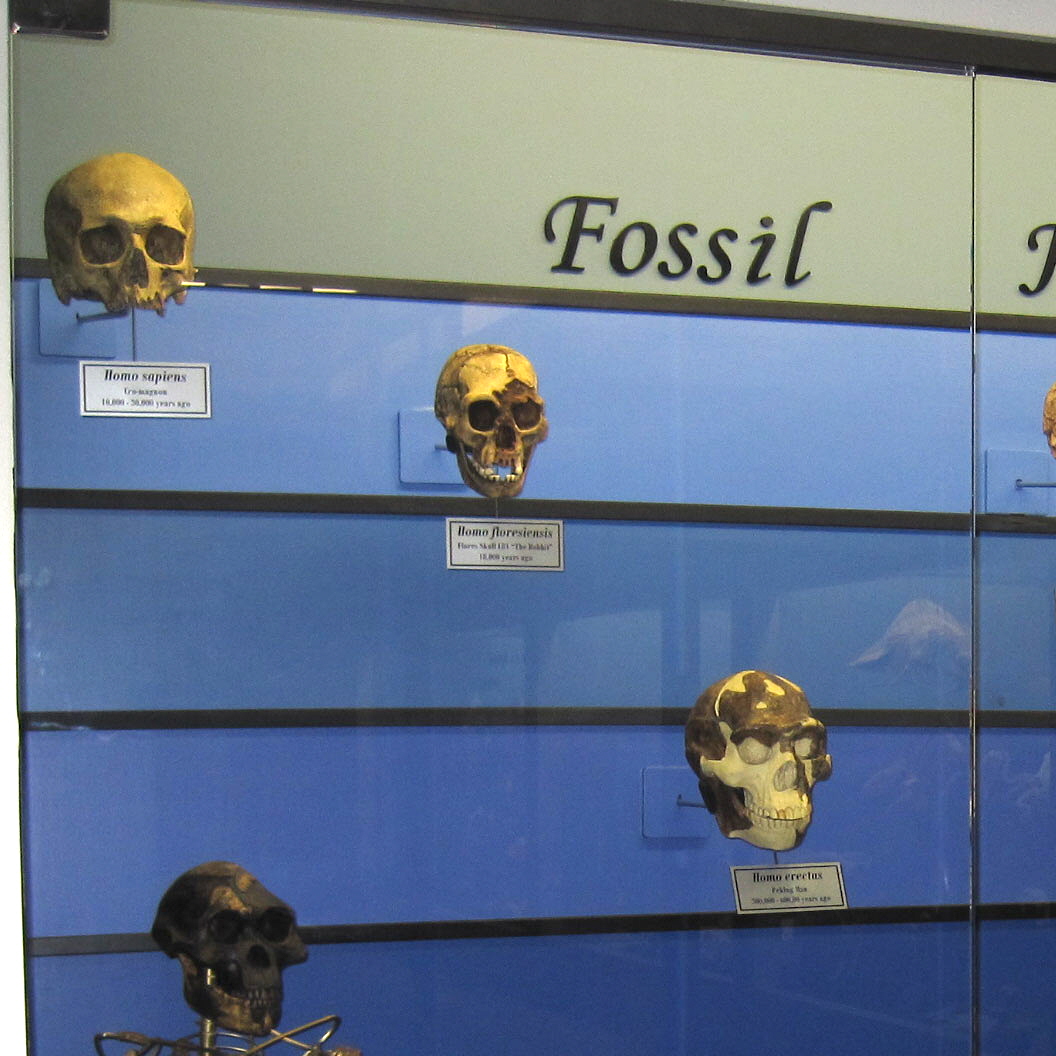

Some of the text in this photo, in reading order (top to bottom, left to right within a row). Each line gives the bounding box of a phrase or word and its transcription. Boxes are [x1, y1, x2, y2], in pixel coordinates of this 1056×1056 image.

[544, 194, 833, 291] Fossil
[105, 369, 187, 384] Homo sapiens
[458, 526, 553, 539] Homo floresiensis
[753, 872, 823, 882] Homo erectus
